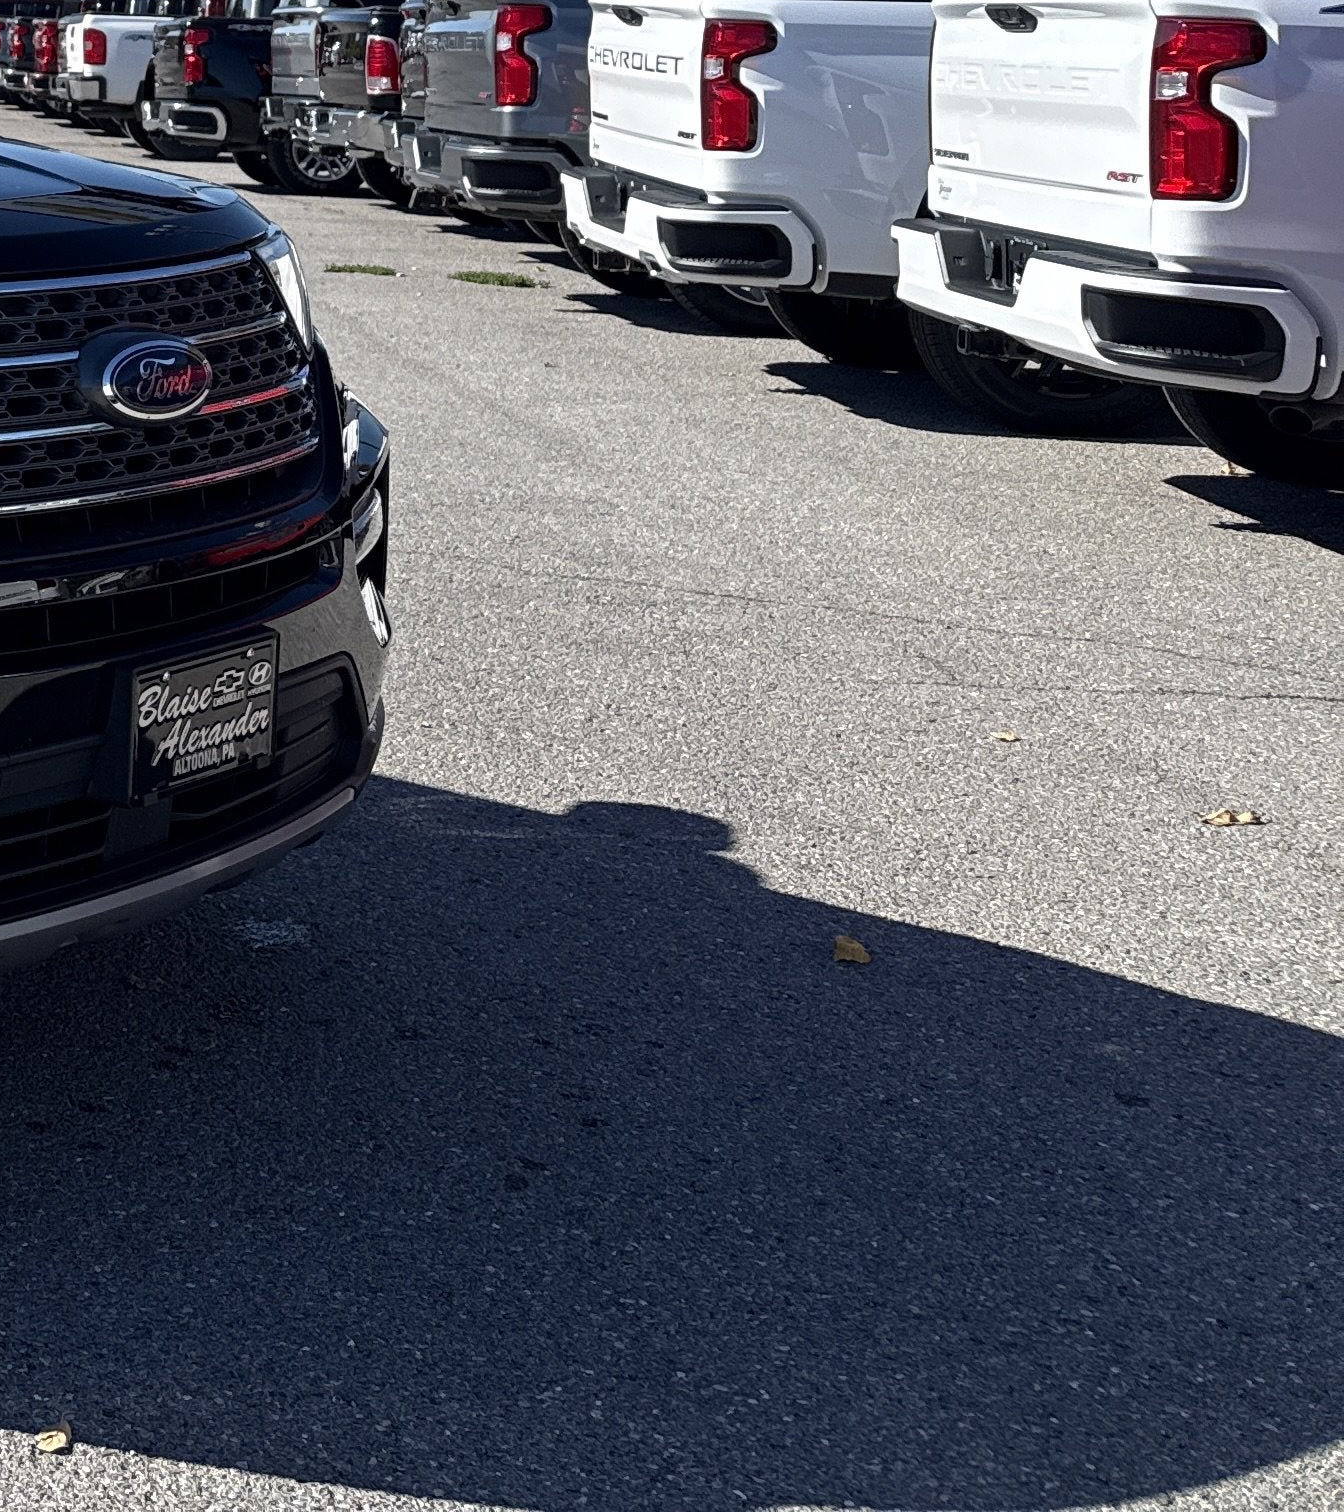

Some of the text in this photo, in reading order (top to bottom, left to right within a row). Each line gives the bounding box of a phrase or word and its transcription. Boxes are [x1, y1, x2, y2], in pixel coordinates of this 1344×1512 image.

[589, 45, 685, 76] CHEVROLET
[1106, 170, 1144, 184] RST
[136, 357, 197, 403] Ford
[137, 684, 211, 728] Blaise
[150, 701, 270, 767] Alexander
[222, 741, 236, 760] PA
